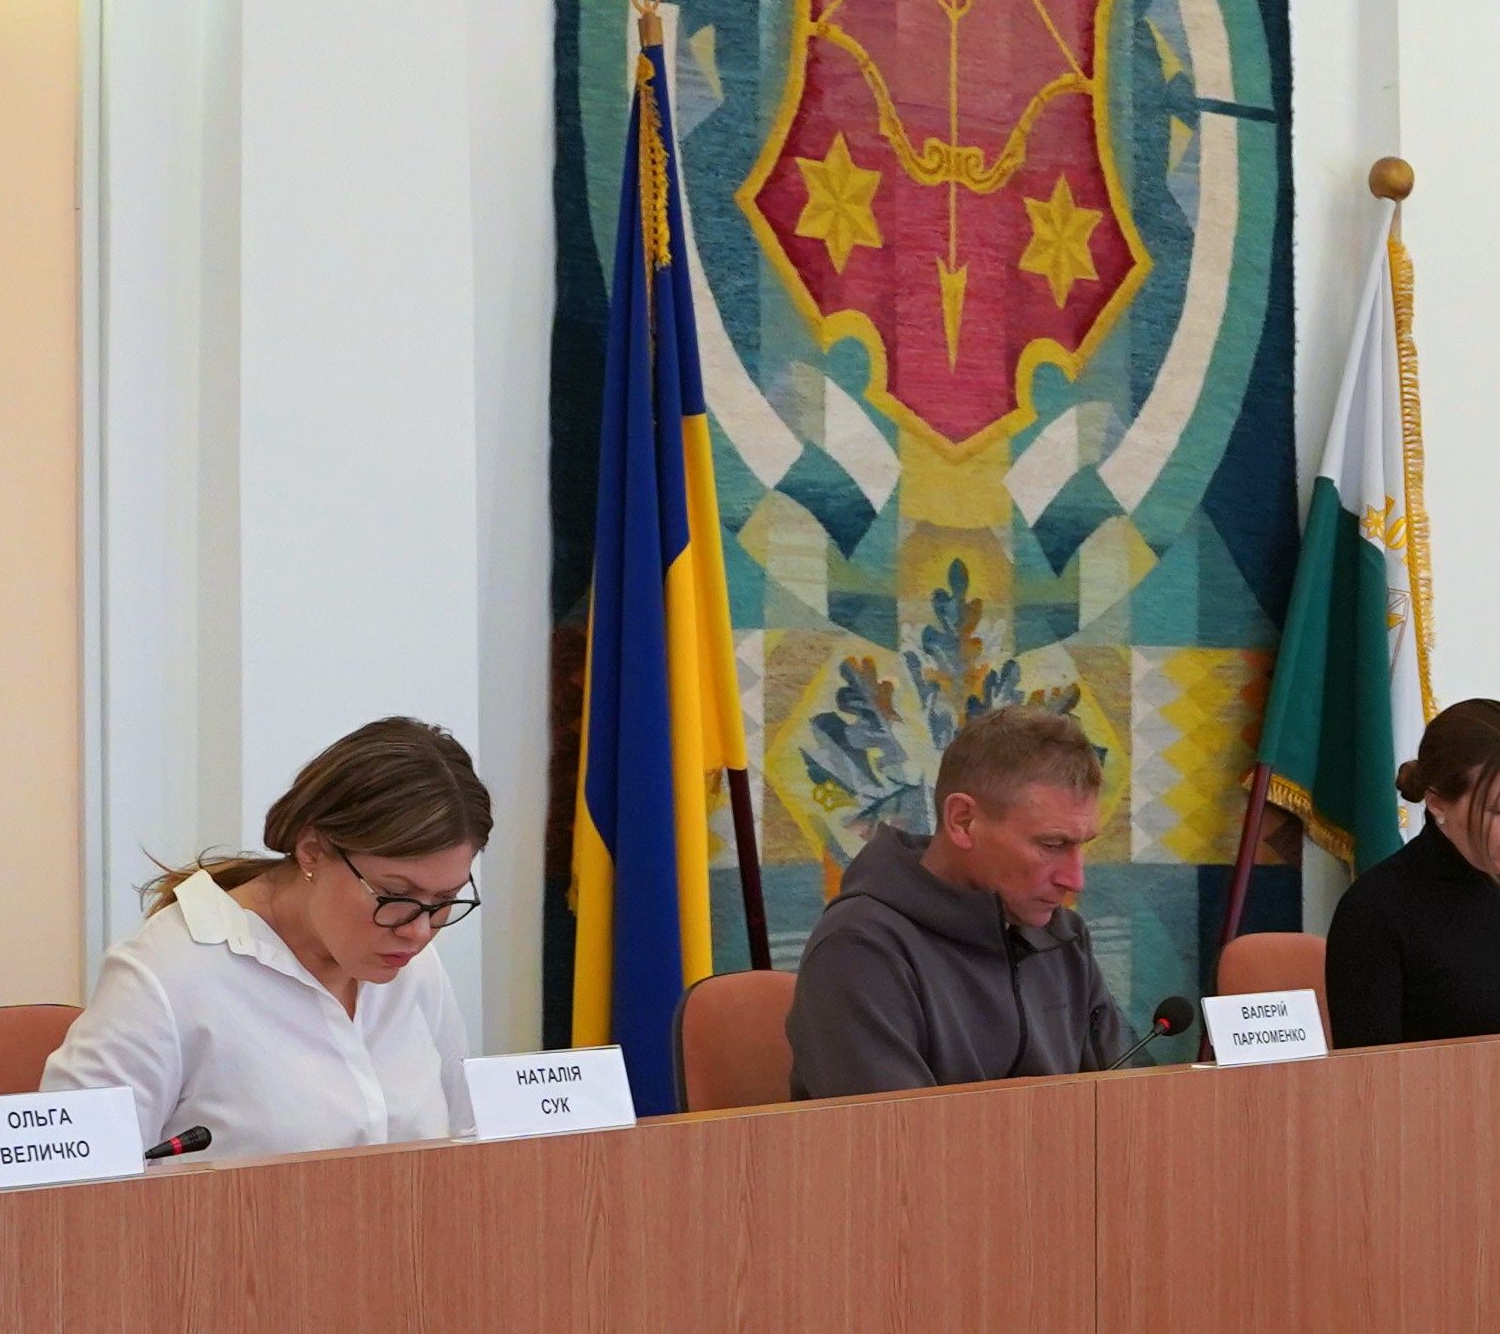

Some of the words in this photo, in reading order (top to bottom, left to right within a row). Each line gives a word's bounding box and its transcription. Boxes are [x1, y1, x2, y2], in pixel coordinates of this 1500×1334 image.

[1241, 1001, 1288, 1020] ВАЛЕРІЙ
[1232, 1028, 1306, 1046] ПАРХОМЕНКО
[516, 1066, 582, 1085] НАТАЛІЯ
[541, 1097, 571, 1114] СУК
[7, 1108, 72, 1129] ОЛЬГА
[0, 1140, 90, 1165] ВЕЛИЧКО
